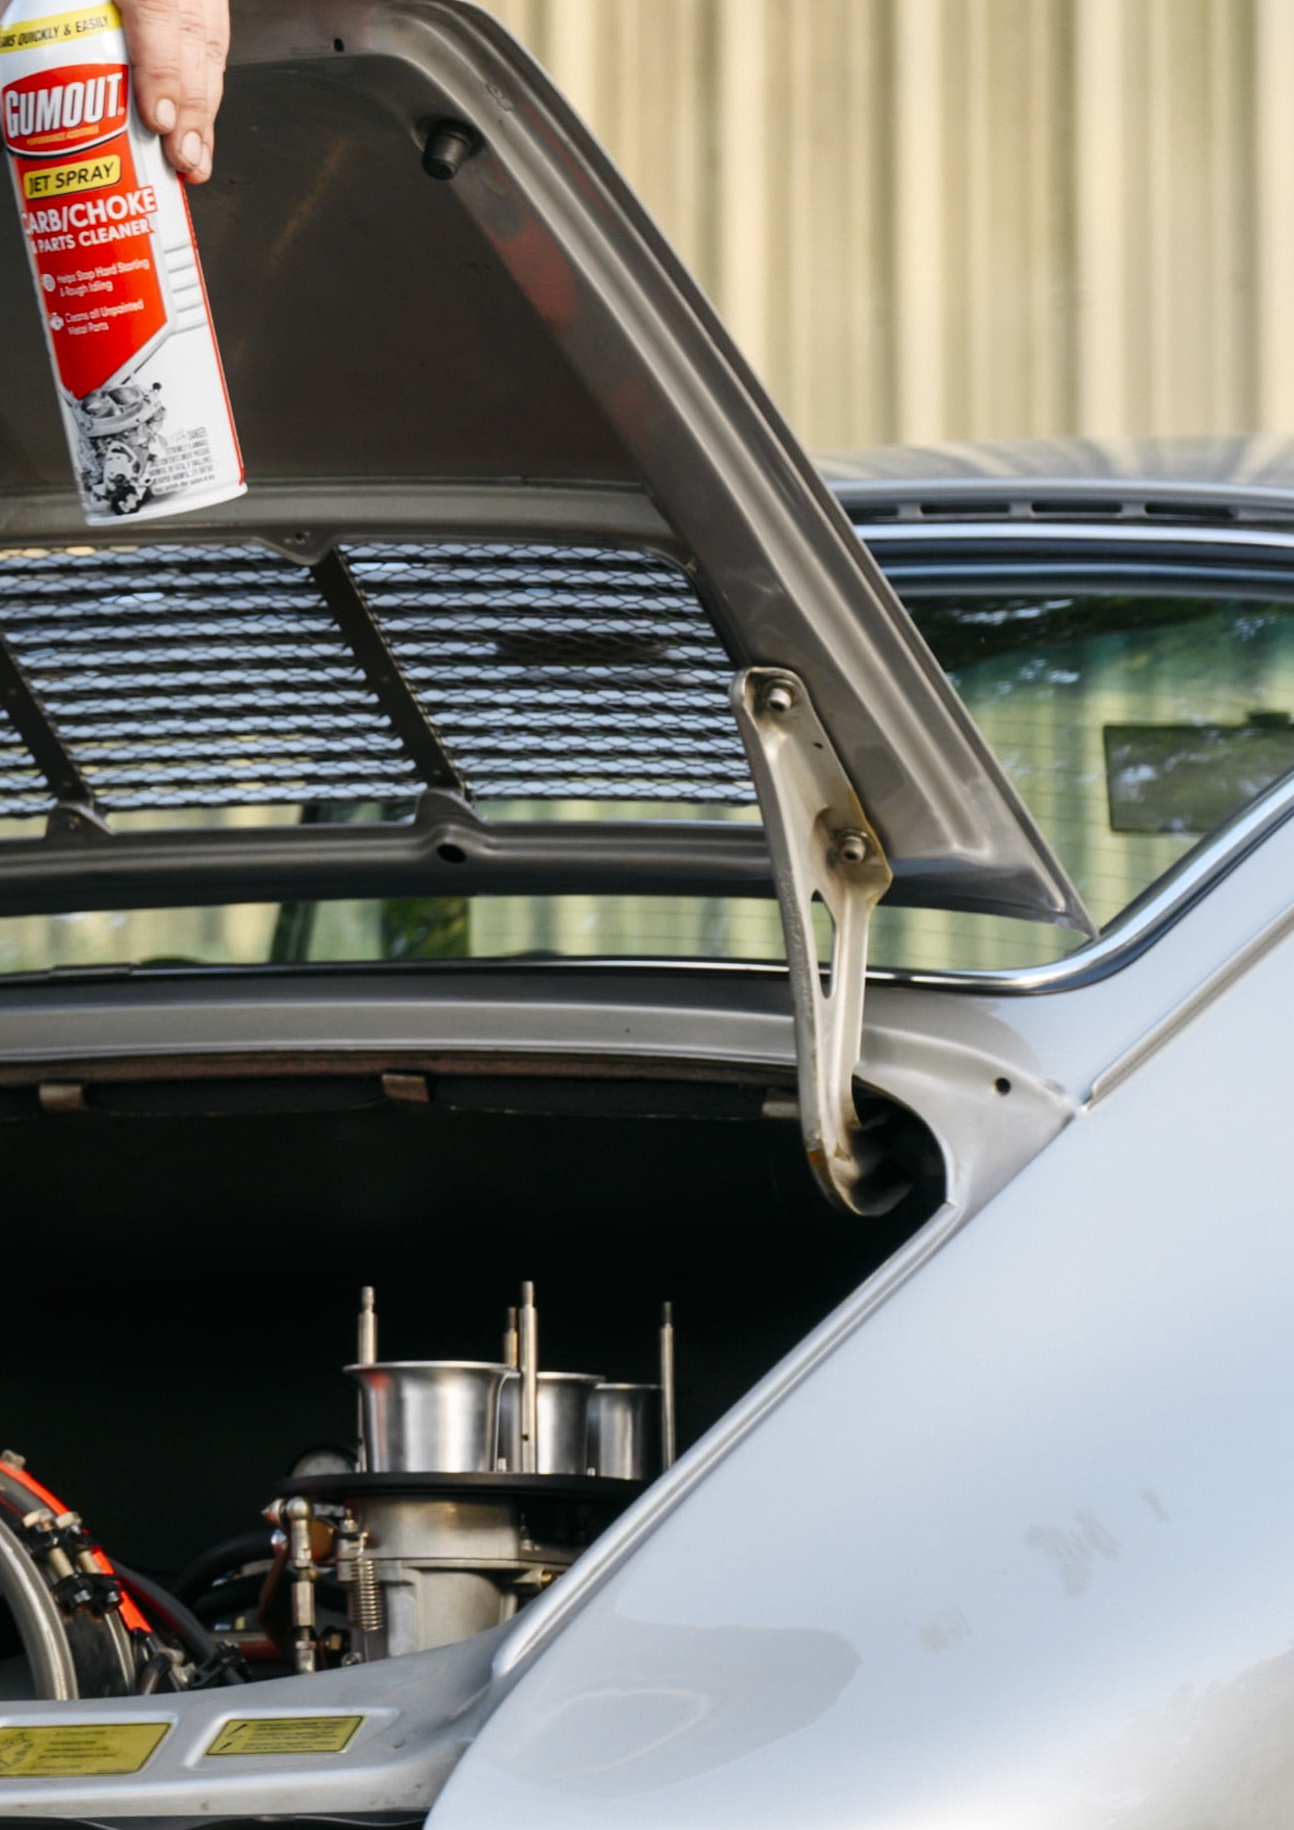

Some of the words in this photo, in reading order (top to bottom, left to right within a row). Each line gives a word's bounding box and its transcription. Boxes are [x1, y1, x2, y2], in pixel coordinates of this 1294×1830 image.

[18, 26, 59, 45] QUICKLY
[63, 23, 72, 37] &
[76, 16, 109, 32] EASILY
[5, 72, 123, 139] GUMOUT
[28, 174, 51, 195] JET
[55, 161, 114, 189] SPRAY
[37, 234, 76, 253] PARTS
[78, 218, 151, 247] CLEANER
